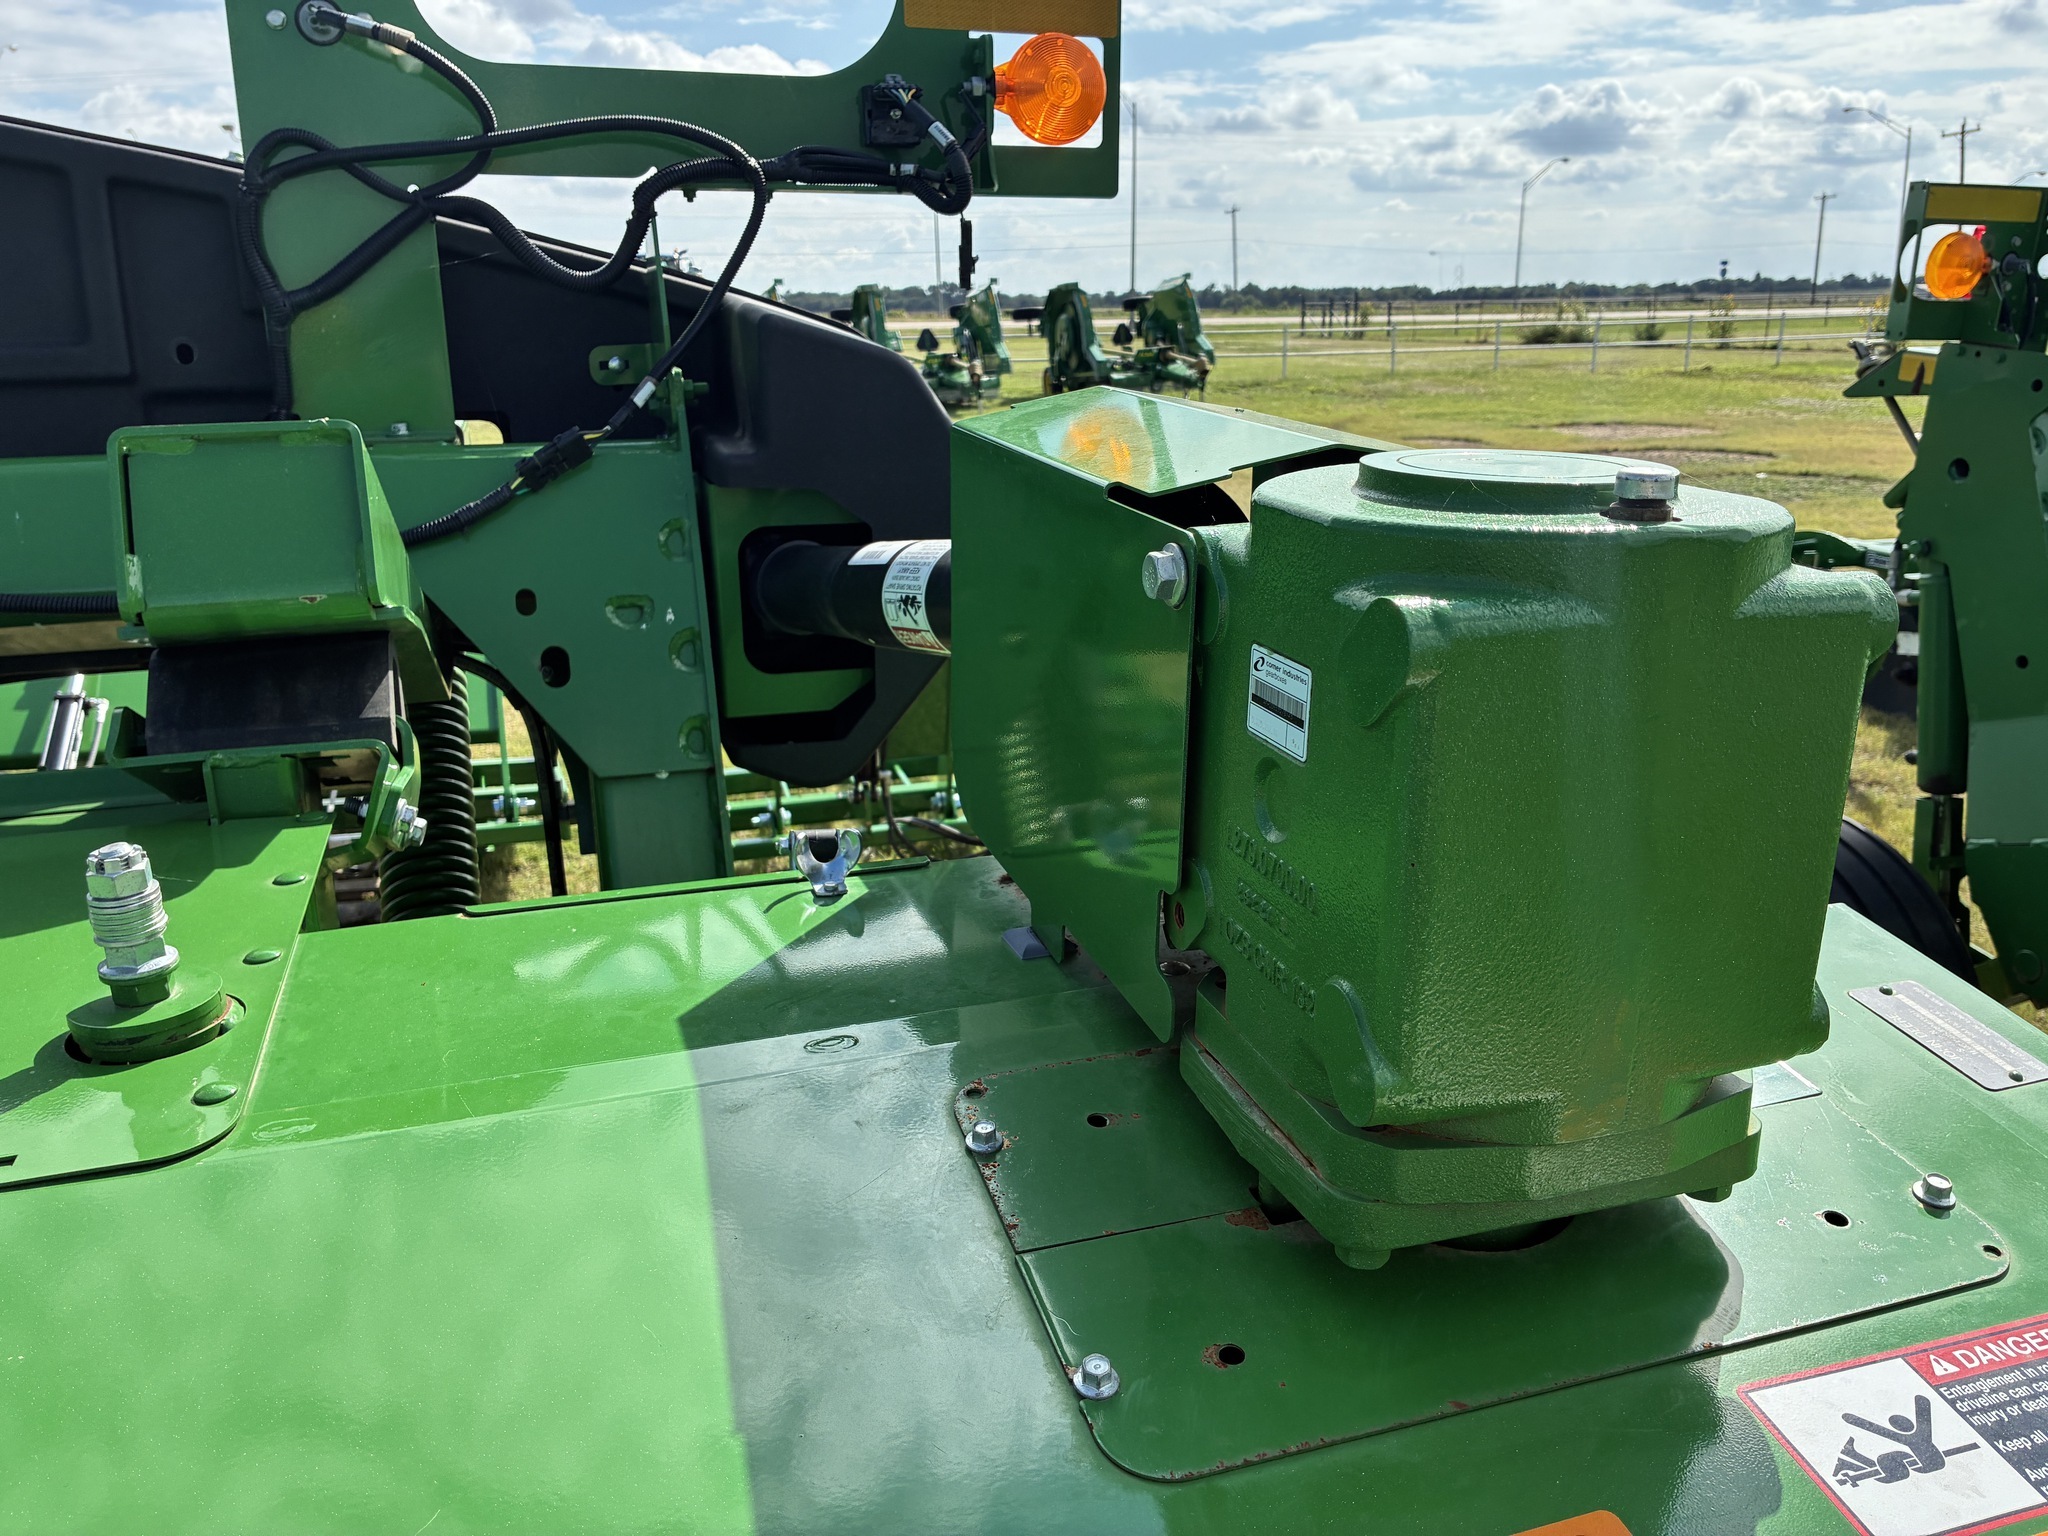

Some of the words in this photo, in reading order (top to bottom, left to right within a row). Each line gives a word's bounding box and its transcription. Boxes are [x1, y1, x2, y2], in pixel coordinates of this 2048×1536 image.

[1265, 669, 1288, 685] gearboxes
[1282, 666, 1308, 687] industries
[1887, 1013, 1927, 1039] DEERE
[1928, 1039, 1962, 1061] JOHN
[1939, 1369, 2027, 1400] Entanglement
[2020, 1367, 2040, 1378] in
[2036, 1361, 2048, 1375] ro
[1955, 1390, 2010, 1412] driveline
[2008, 1385, 2035, 1399] can
[2032, 1380, 2048, 1393] ca
[1966, 1408, 2009, 1427] injury
[2006, 1404, 2022, 1416] or
[2021, 1394, 2048, 1412] deat
[1993, 1436, 2032, 1453] Keep
[2030, 1429, 2048, 1444] all
